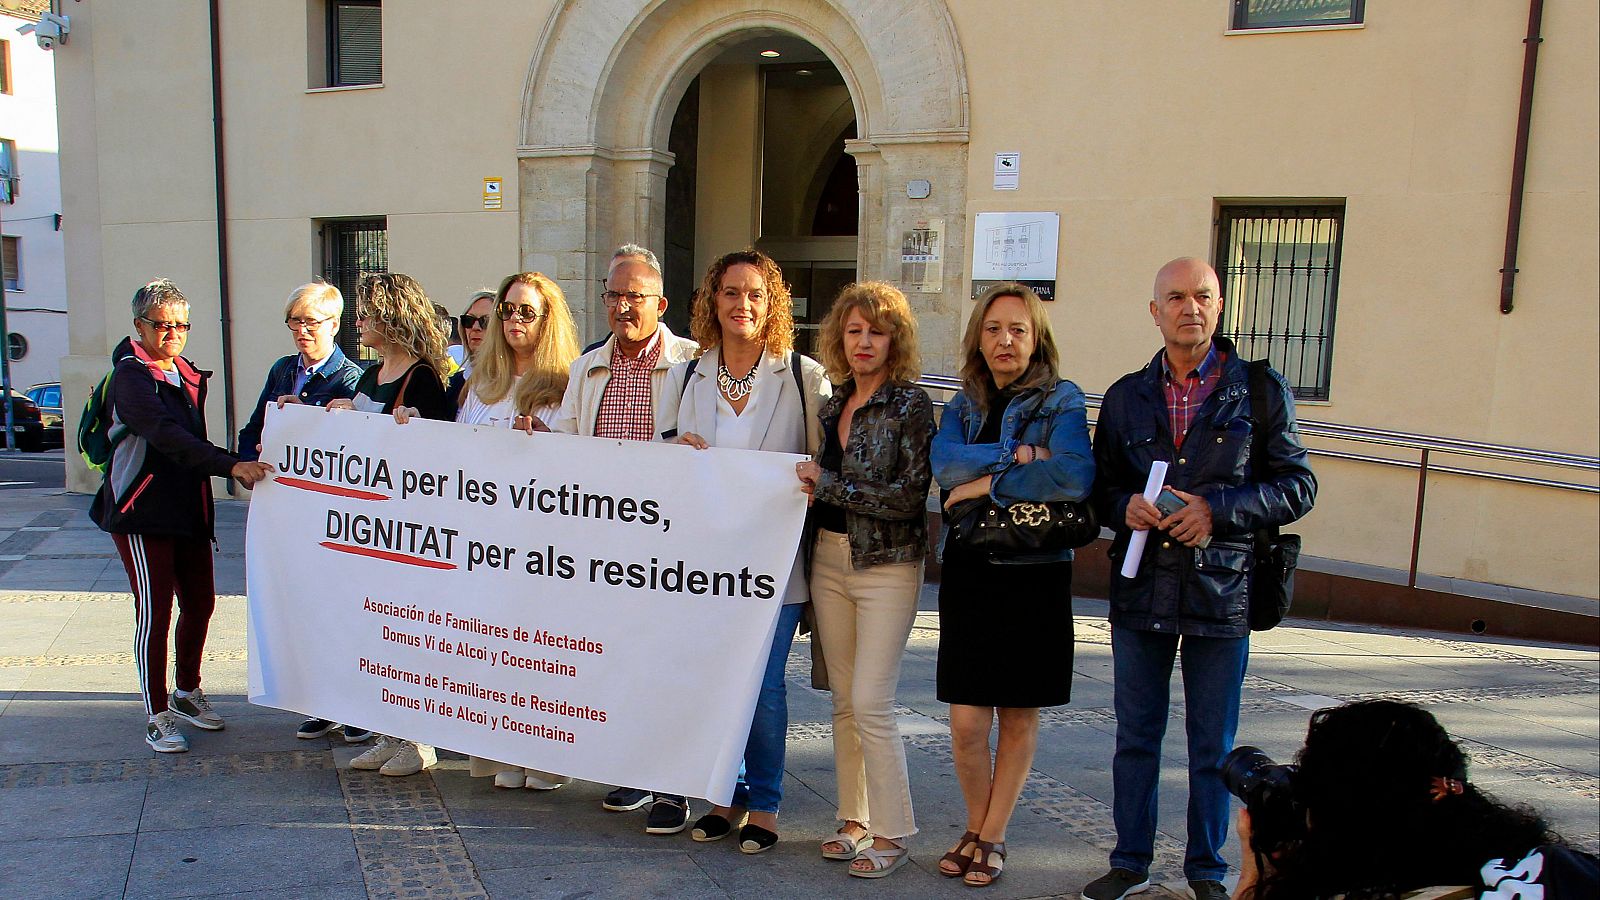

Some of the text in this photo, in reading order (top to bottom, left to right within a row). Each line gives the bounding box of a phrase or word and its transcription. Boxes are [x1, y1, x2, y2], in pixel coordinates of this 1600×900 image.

[278, 445, 672, 533] JUSTÍCIA per les víctimes,
[326, 509, 776, 600] DIGNITAT per als residents
[363, 596, 603, 655] Asociación de Familiares de Afectados
[382, 625, 577, 678] Domus Vi de Alcoi y Cocentaina
[359, 657, 607, 723] Plataforma de Familiares de Residentes
[381, 687, 575, 744] Domus Vi de Alcoi y Cocentaina
